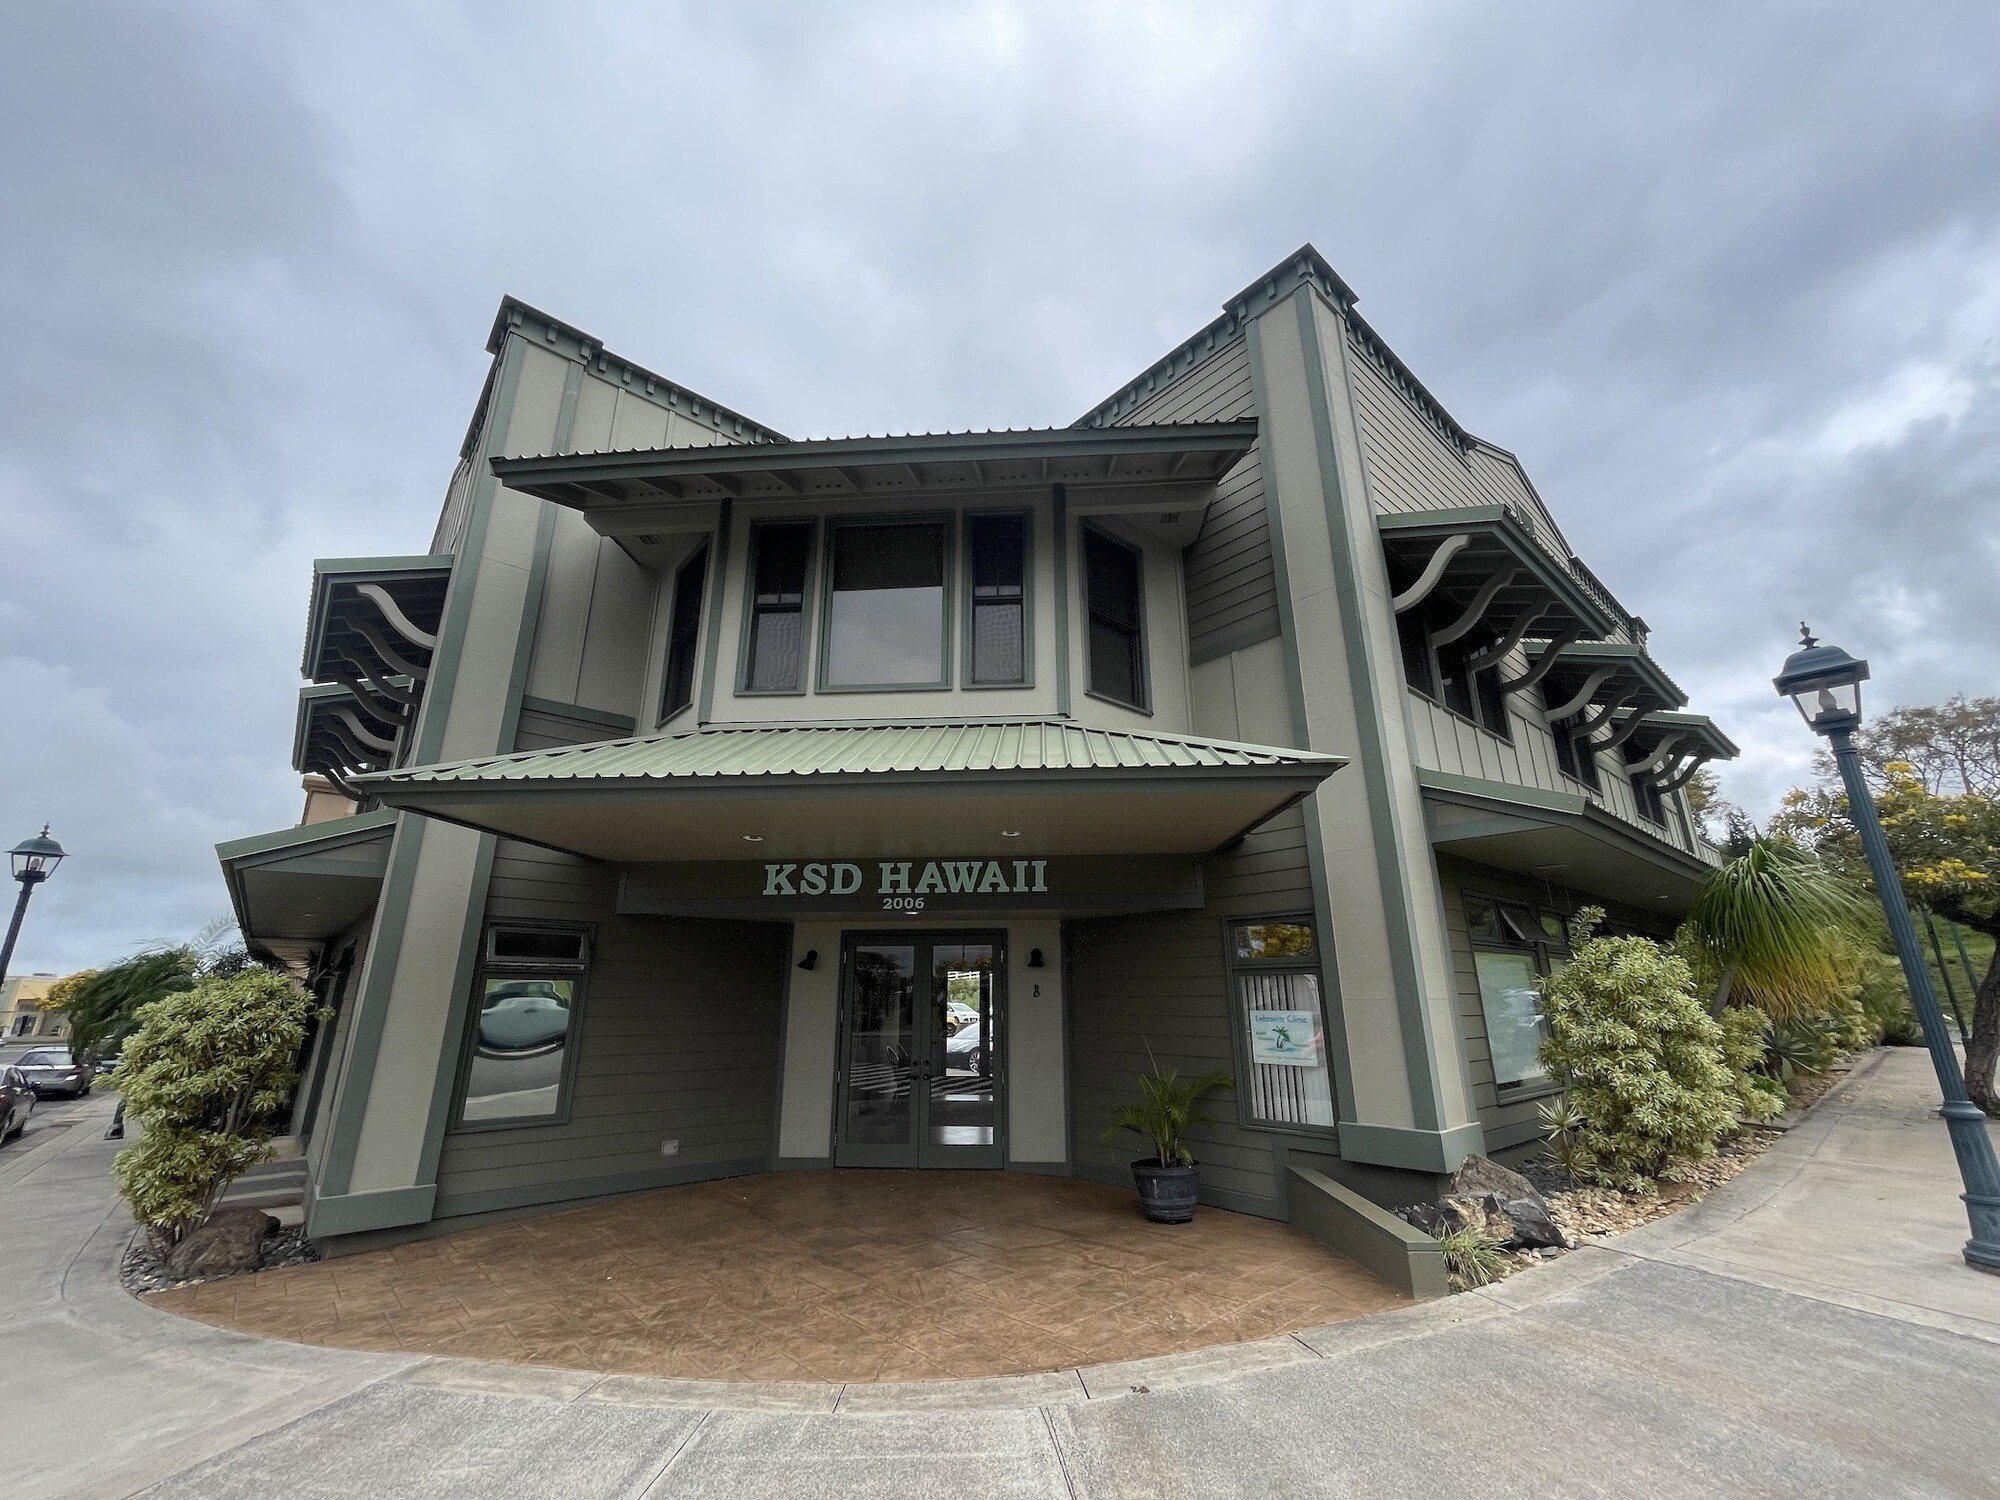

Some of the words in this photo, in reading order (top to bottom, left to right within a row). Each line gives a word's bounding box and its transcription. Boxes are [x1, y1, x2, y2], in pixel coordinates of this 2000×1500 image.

[762, 862, 863, 896] KSD
[877, 860, 1048, 894] HAWAII
[883, 897, 925, 910] 2006
[1033, 984, 1040, 998] 8
[1287, 1014, 1308, 1024] Clinic
